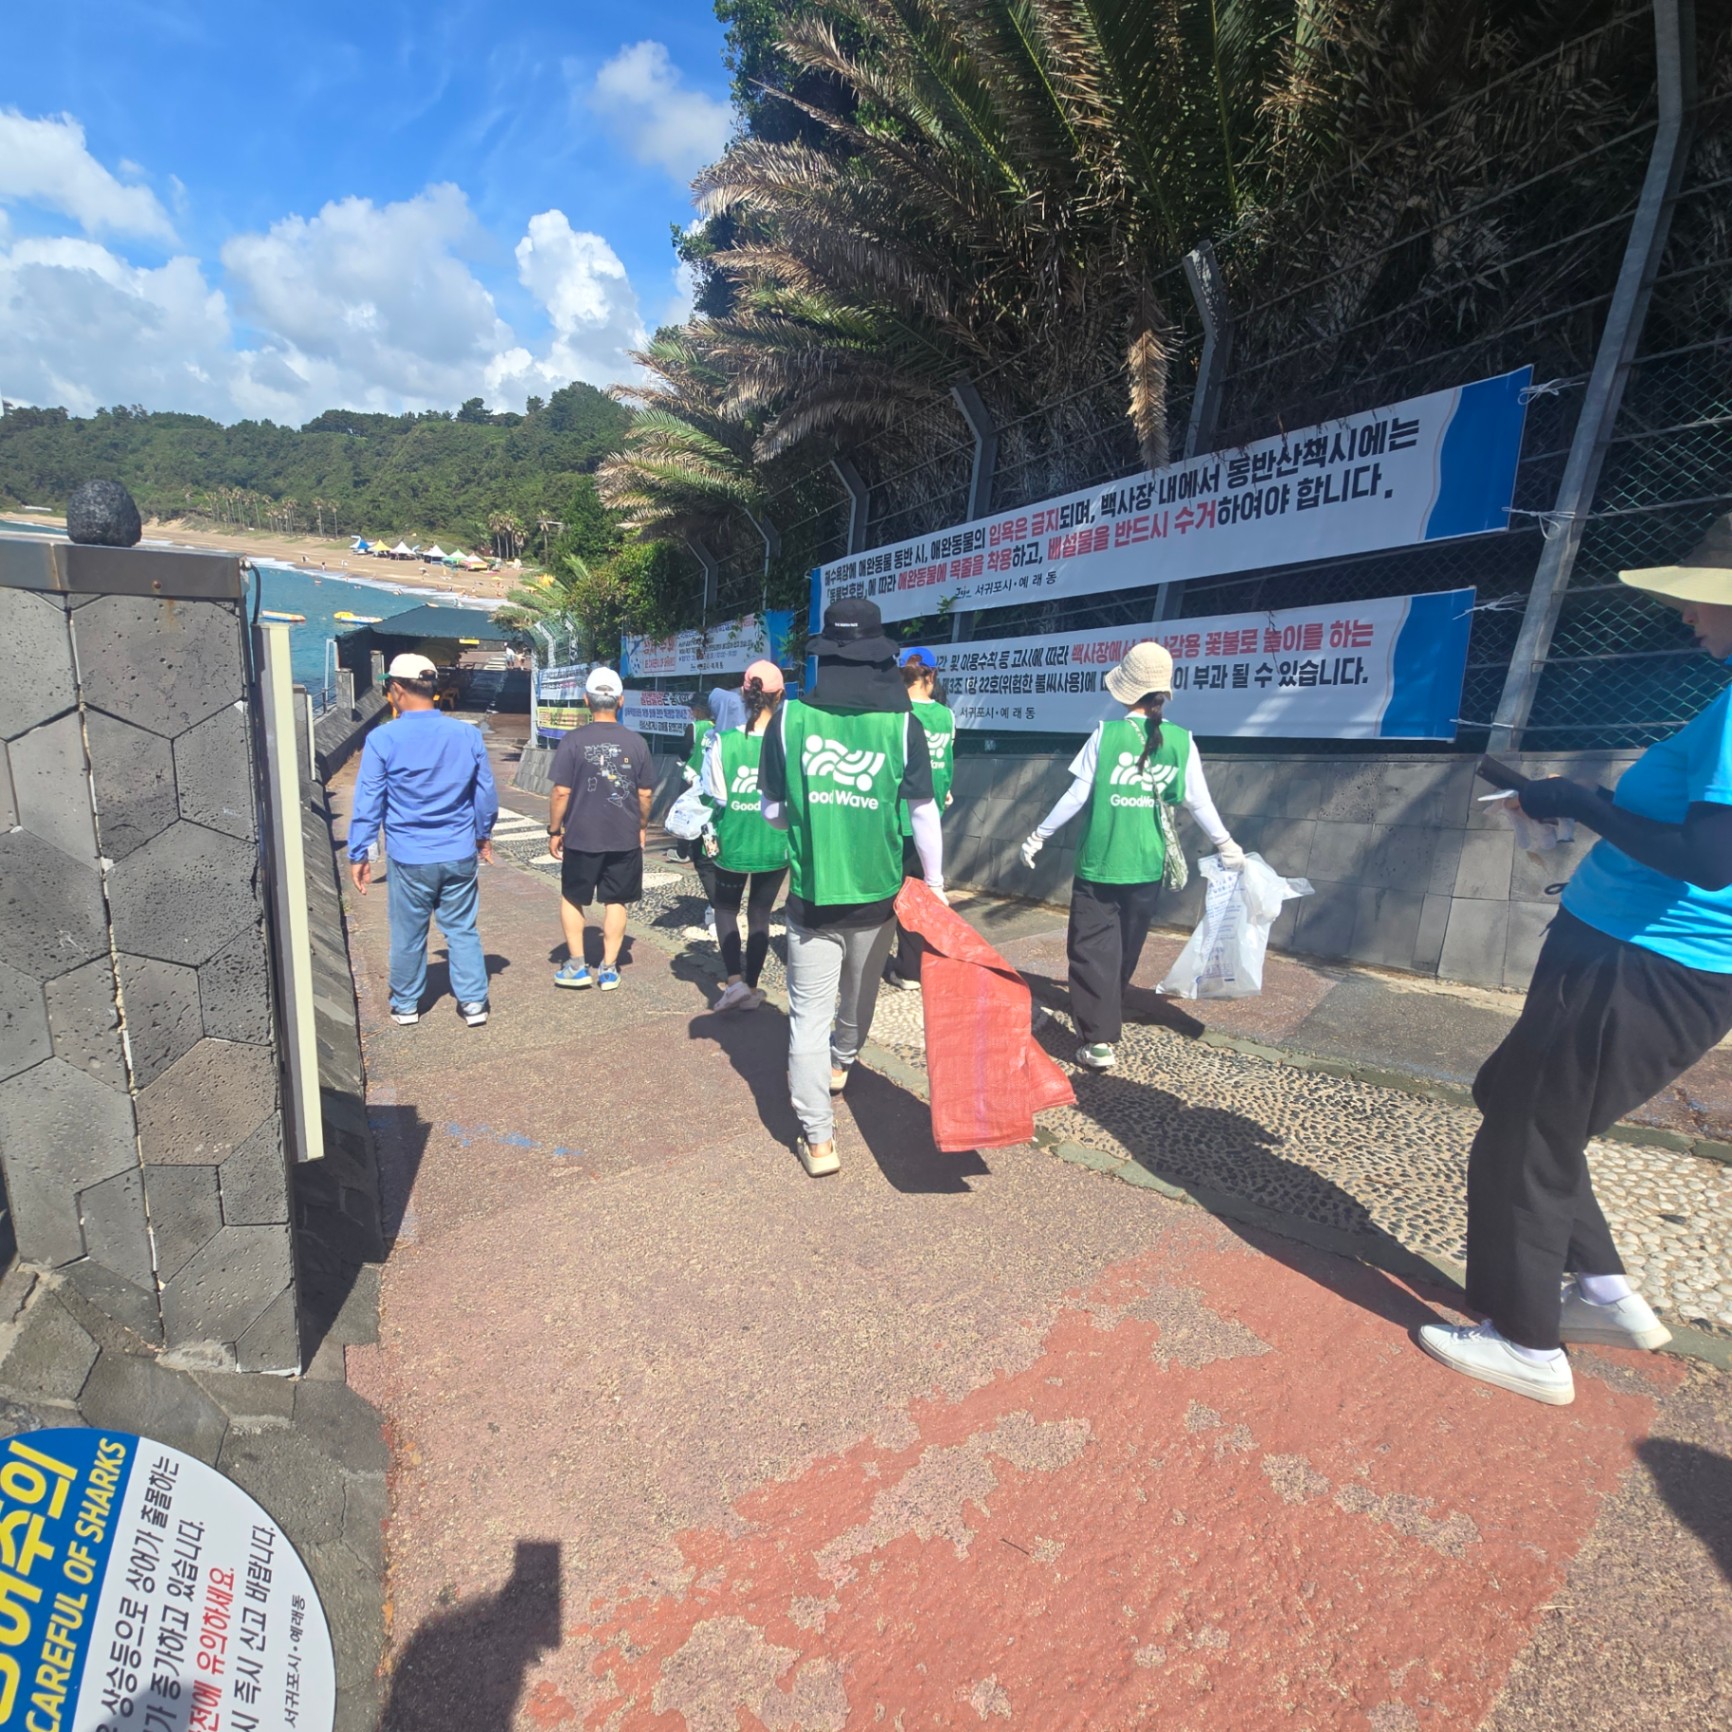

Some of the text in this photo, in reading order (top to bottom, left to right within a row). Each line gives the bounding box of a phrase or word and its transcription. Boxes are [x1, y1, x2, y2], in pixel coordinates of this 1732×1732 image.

[825, 417, 1420, 587] 해수욕장에 애완동물 동반 시, 애완동물의 입욕은 금지되며, 백사장 내에서 동반산책시에는
[878, 574, 897, 595] 따라
[898, 562, 947, 591] 애완동물에
[950, 553, 984, 580] 목줄을
[987, 541, 1043, 573] 착용하고,
[1047, 524, 1110, 561] 배설물을
[1114, 510, 1169, 548] 반드시
[1174, 483, 1290, 535] 수거하여야
[1296, 462, 1393, 511] 합니다.
[950, 654, 960, 672] 및
[960, 650, 997, 671] 이용수칙
[998, 649, 1010, 669] 등
[1011, 647, 1044, 668] 고시에
[1045, 645, 1069, 665] 따라
[1205, 628, 1259, 657] 꽃불로
[1264, 622, 1324, 653] 놀이를
[1329, 619, 1374, 648] 하는
[1193, 663, 1228, 690] 부과
[1232, 663, 1249, 689] 될
[1254, 661, 1273, 689] 수
[1278, 656, 1369, 688] 있습니다.
[730, 800, 762, 811] Good
[808, 789, 879, 810] ood Wave
[140, 1456, 179, 1529] 출몰하는
[25, 1437, 126, 1732] CAREFUL OF SHARKS
[125, 1528, 165, 1594] 상어가
[166, 1519, 205, 1602] 있습니다.
[245, 1525, 276, 1604] 바랍니다.
[101, 1596, 149, 1718] 상승등으로
[150, 1604, 190, 1701] 증가하고
[187, 1567, 235, 1732] 전에 유의하세요.
[239, 1606, 267, 1652] 신고
[234, 1655, 263, 1705] 즉시
